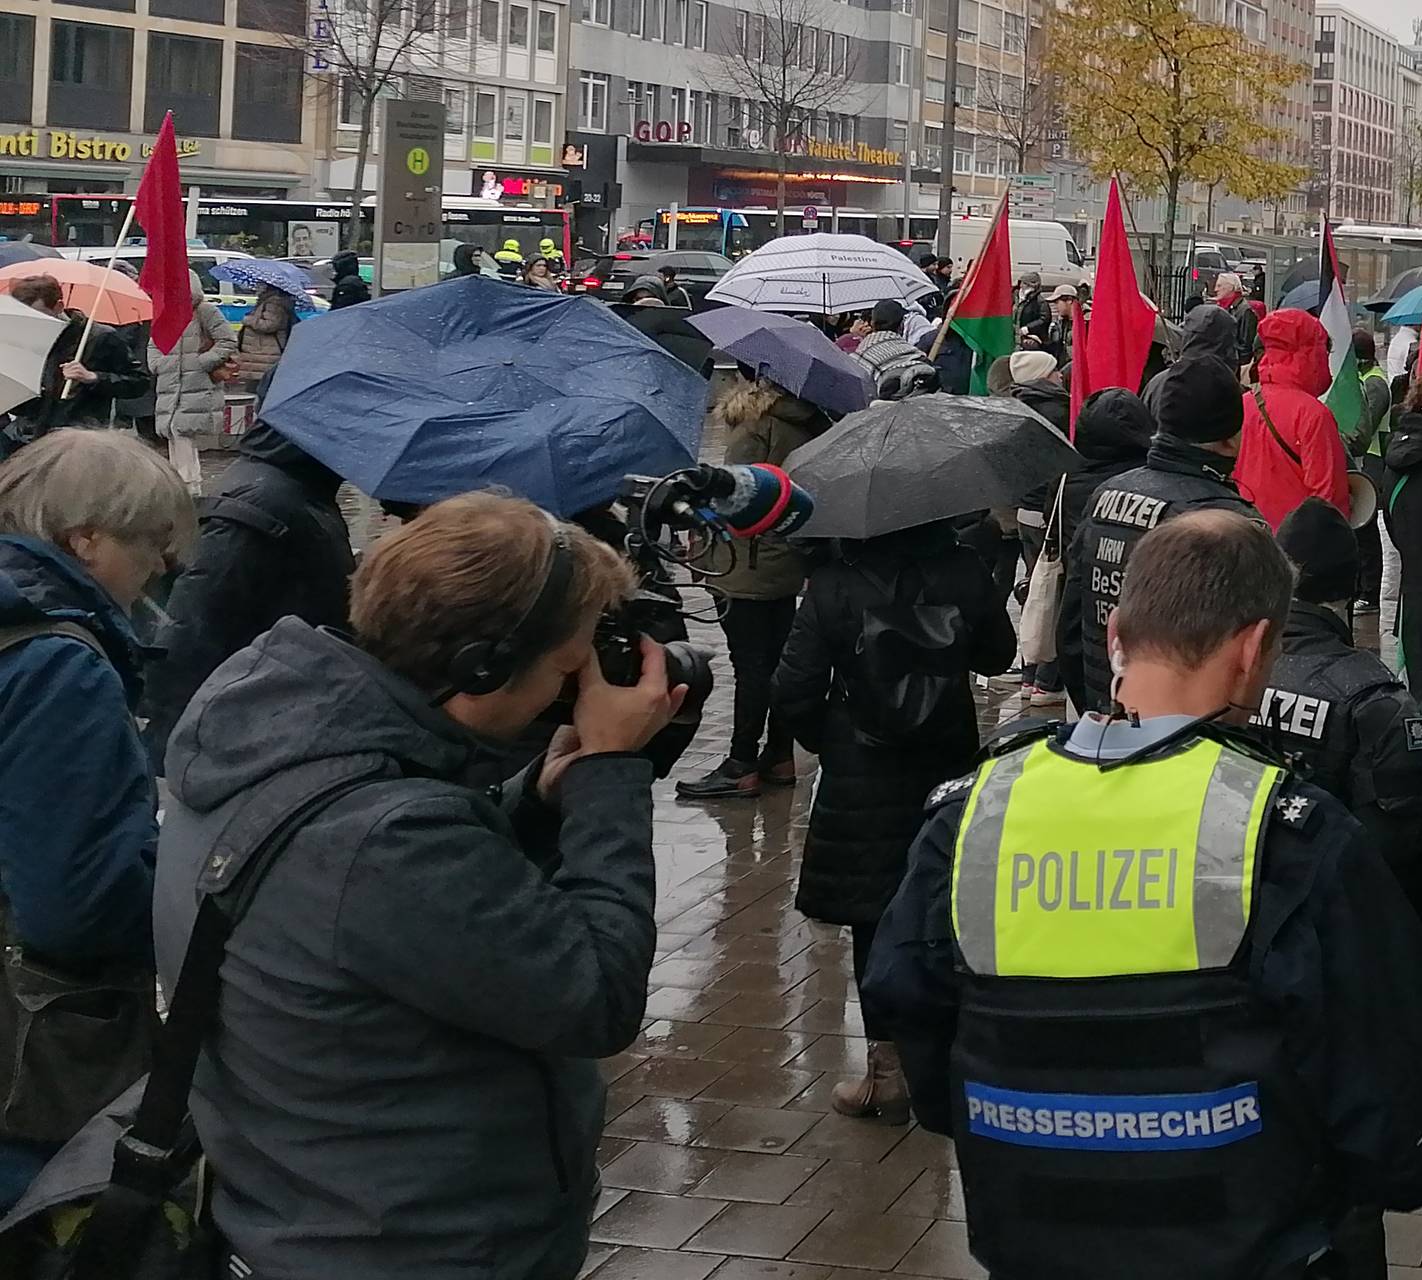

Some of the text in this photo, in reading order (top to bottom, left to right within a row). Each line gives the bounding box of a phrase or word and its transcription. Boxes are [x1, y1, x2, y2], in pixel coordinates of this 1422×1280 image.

[50, 131, 132, 161] Bistro
[831, 254, 878, 264] Palestine
[1093, 490, 1167, 529] POLIZEI
[1096, 537, 1125, 564] NRW
[1092, 566, 1128, 596] BeS
[1011, 848, 1178, 912] POLIZEI
[968, 1095, 1260, 1139] PRESSESPRECHER
